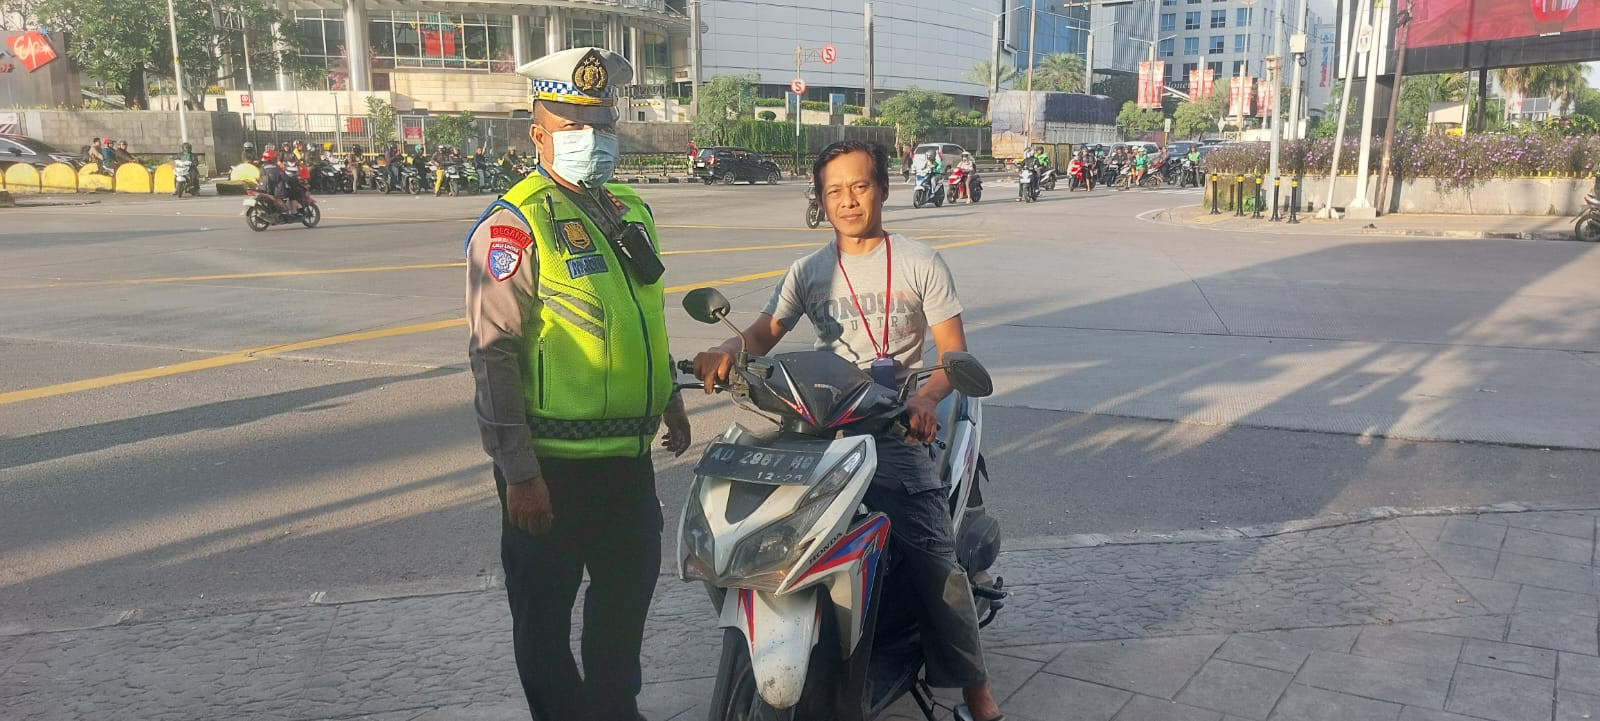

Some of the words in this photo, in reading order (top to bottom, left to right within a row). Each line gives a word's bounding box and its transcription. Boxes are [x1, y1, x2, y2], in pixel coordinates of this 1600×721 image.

[825, 48, 833, 60] S
[795, 81, 801, 92] S
[492, 227, 528, 246] GEGANA
[808, 532, 842, 564] HONDA
